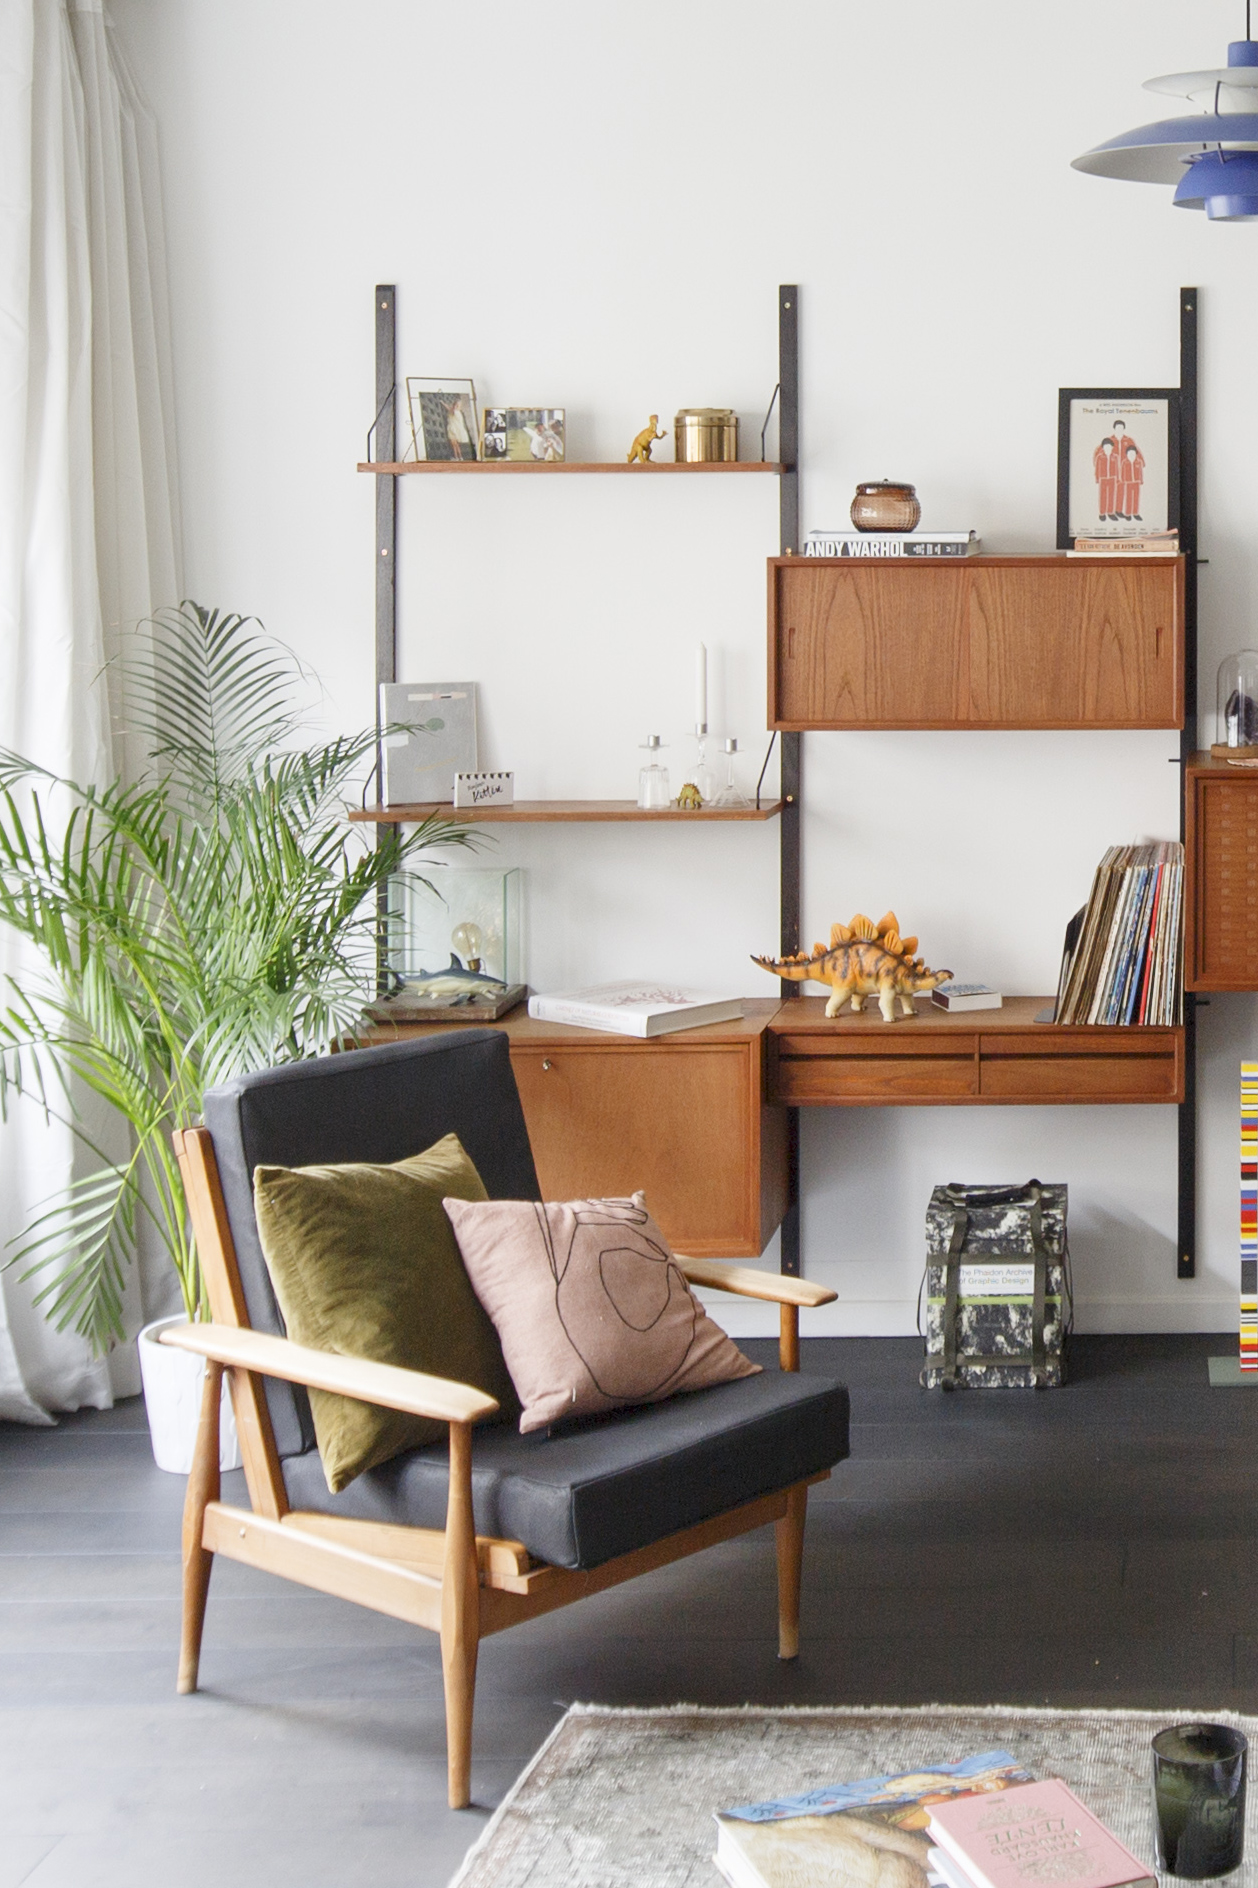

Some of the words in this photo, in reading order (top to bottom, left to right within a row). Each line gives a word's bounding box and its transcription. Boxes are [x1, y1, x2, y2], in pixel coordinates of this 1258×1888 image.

[805, 541, 845, 557] ANDY
[847, 541, 908, 557] WARHOL
[974, 1268, 1004, 1276] Phaidon
[1006, 1268, 1033, 1276] Archive
[968, 1277, 1000, 1286] Graphic
[1001, 1277, 1029, 1286] Design
[1042, 1839, 1081, 1855] KARL
[1006, 1849, 1038, 1863] OVE
